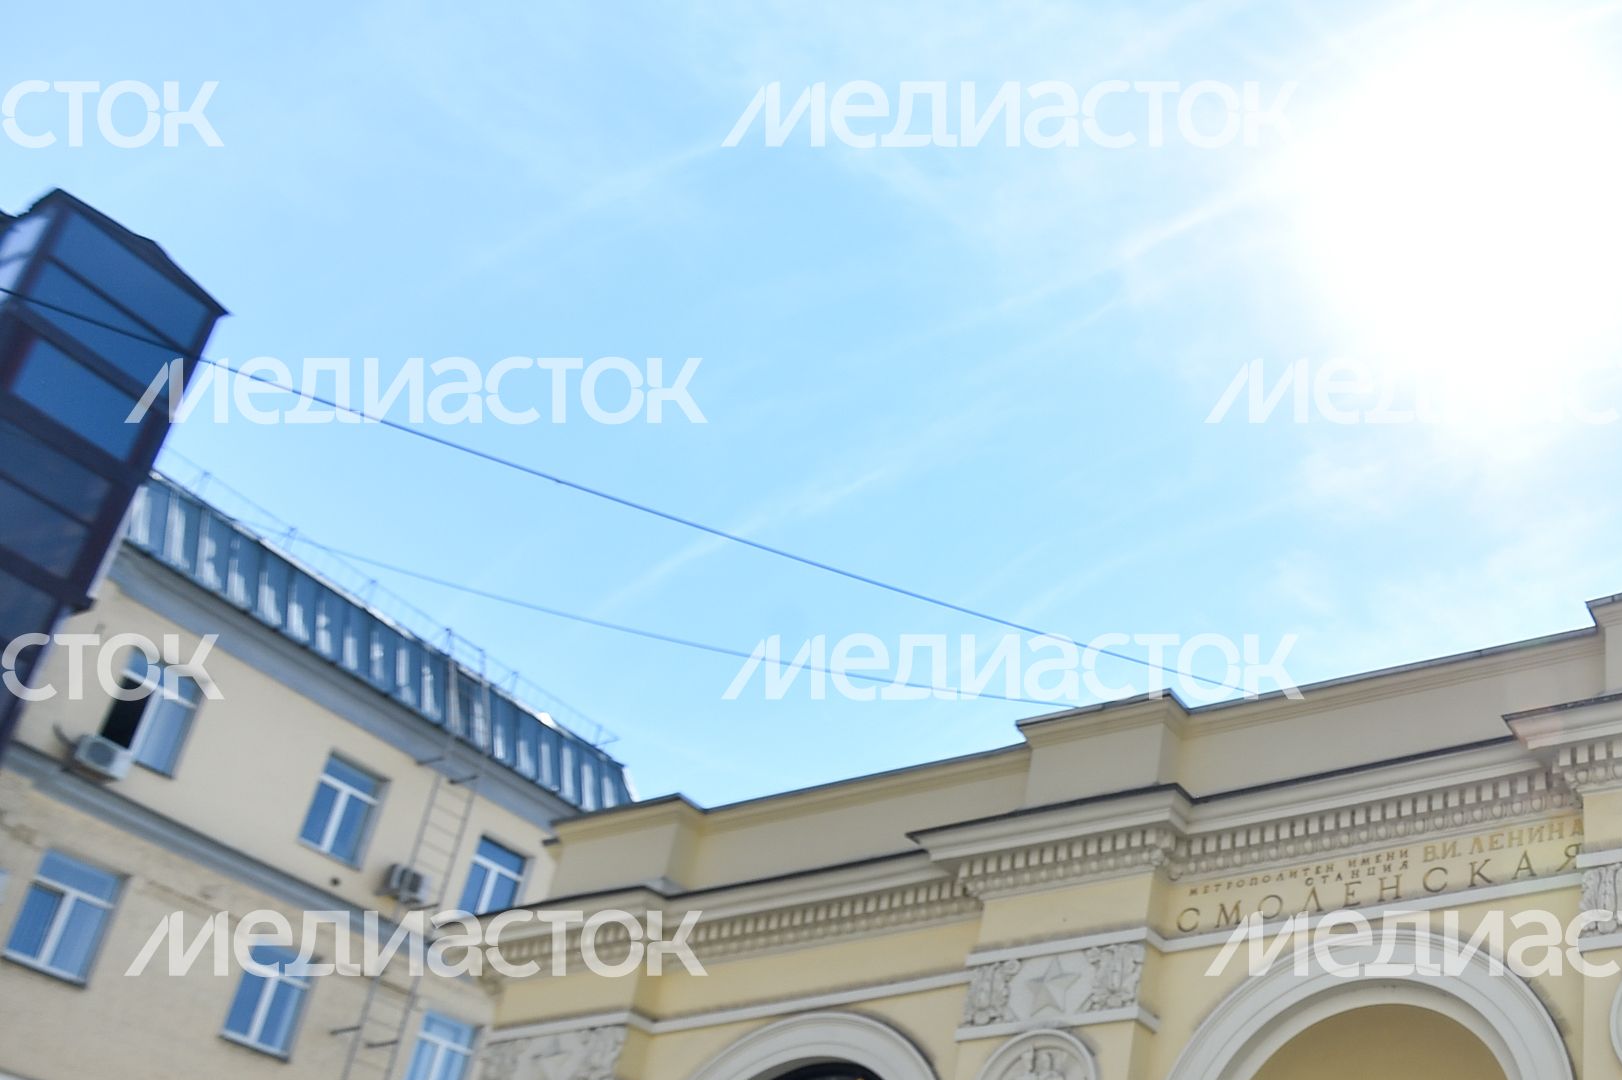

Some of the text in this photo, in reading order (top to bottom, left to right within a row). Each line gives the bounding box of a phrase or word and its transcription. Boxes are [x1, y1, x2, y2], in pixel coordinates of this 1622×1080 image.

[1176, 843, 1582, 933] СМОЛЕНСКАЯ
[1189, 863, 1335, 896] МЕТРОПОЛИТЕН
[1348, 848, 1409, 868] ИМЕНИ
[1469, 818, 1584, 855] ЛЕНИНА
[1304, 862, 1409, 886] СТАНЦИЯ
